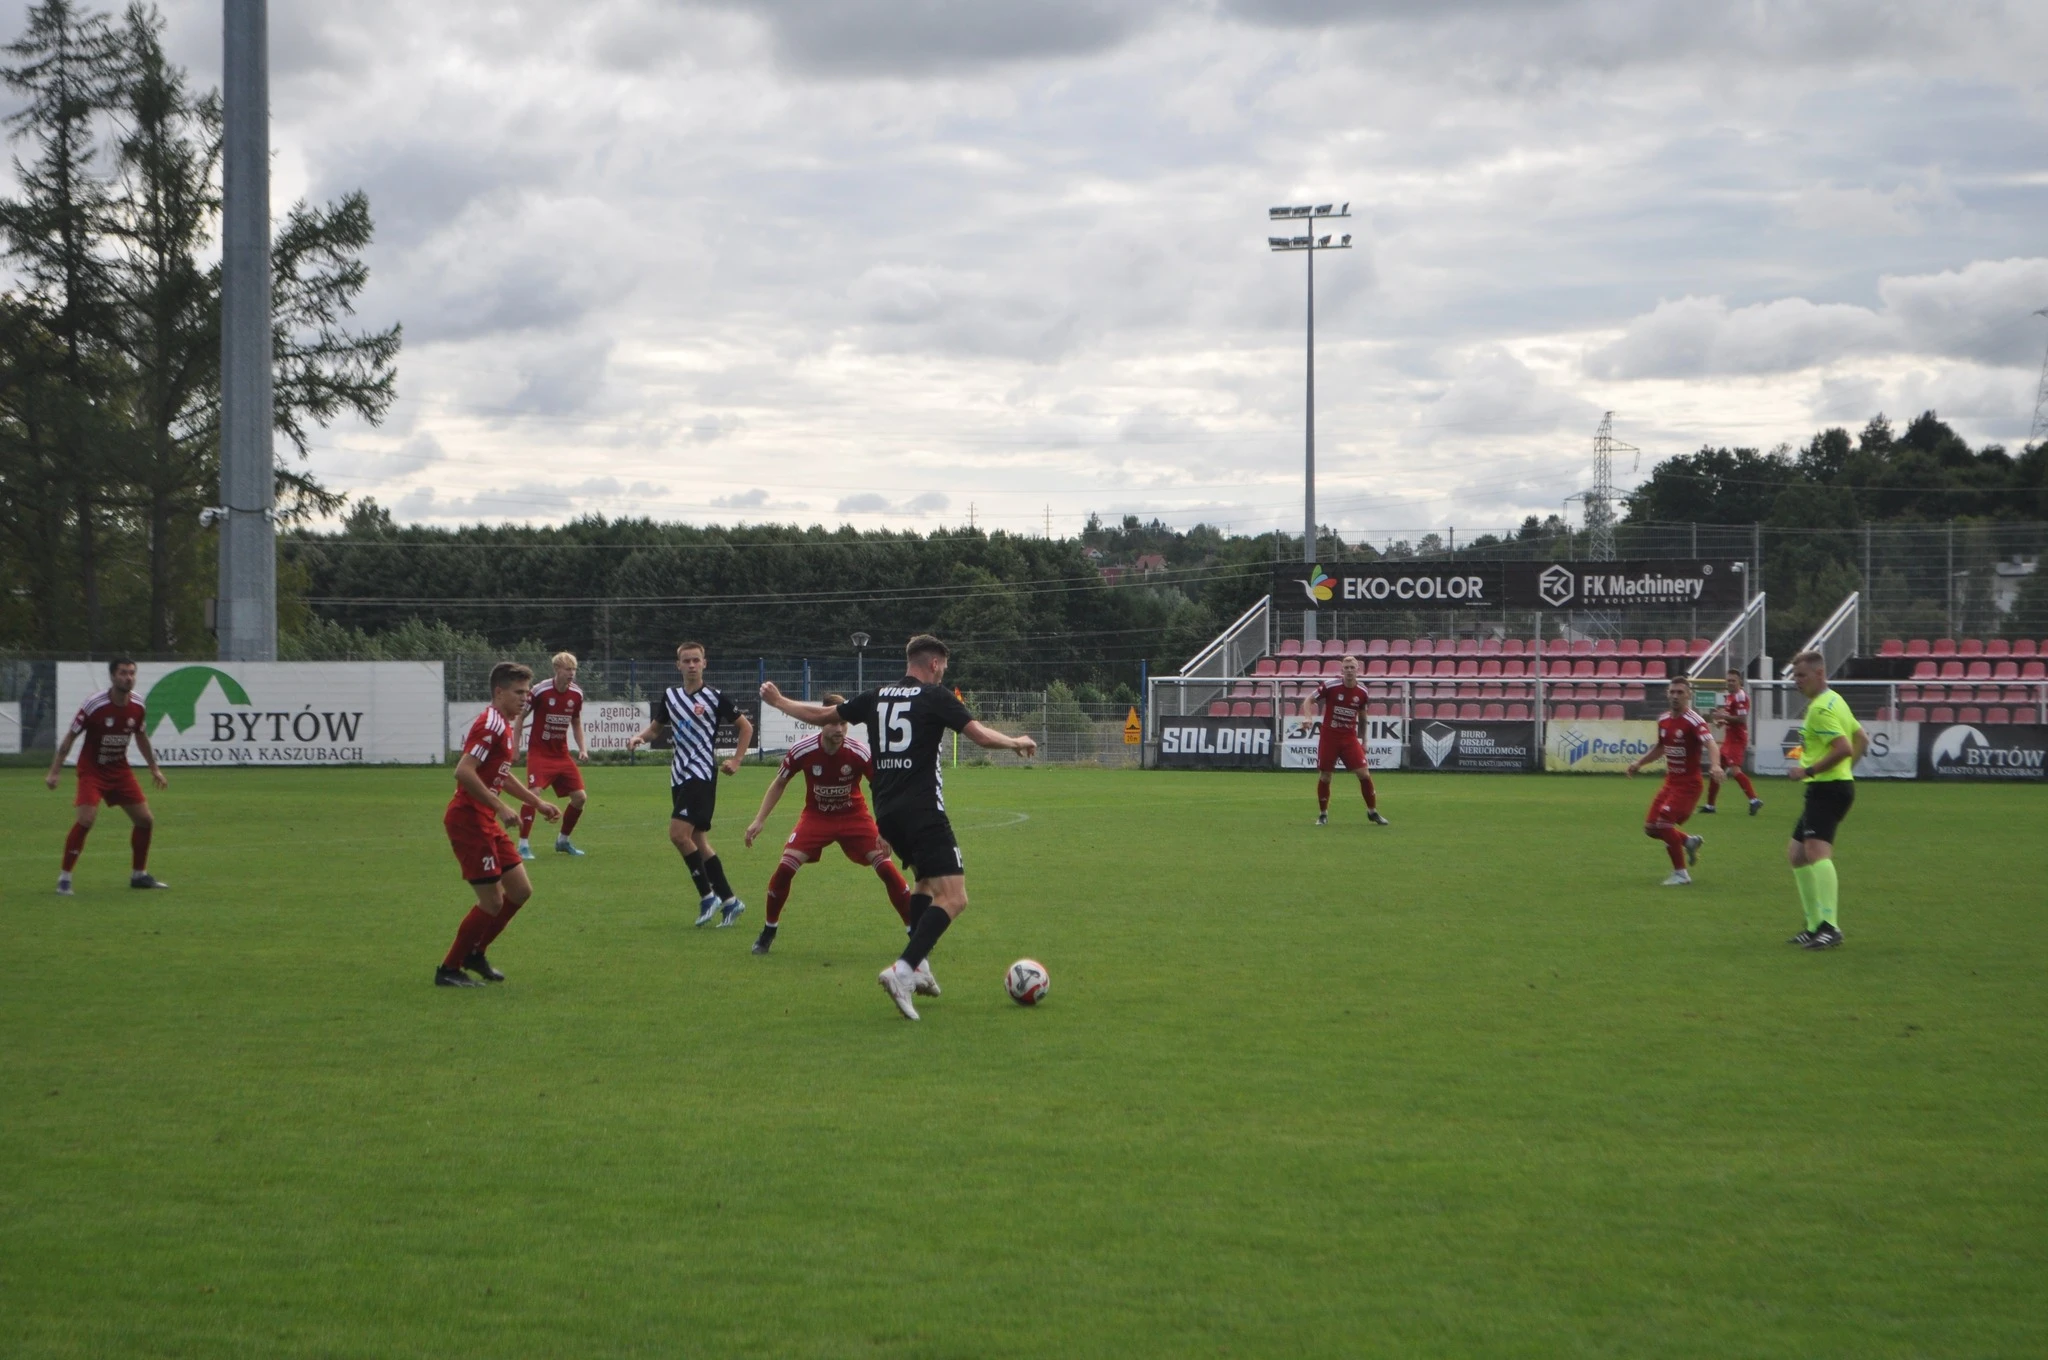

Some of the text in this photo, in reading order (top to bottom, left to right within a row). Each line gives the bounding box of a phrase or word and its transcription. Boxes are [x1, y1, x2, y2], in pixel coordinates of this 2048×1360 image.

[1343, 576, 1484, 599] EKO-COLOR
[1583, 575, 1606, 596] FK
[1609, 573, 1704, 599] Machinery
[600, 704, 641, 720] agencja
[209, 704, 364, 743] BYTÓW
[583, 720, 640, 733] reklamowa
[876, 701, 913, 753] 15
[1162, 727, 1272, 755] SOLDAR
[1460, 730, 1487, 738] BIURO
[1459, 738, 1495, 747] OBSŁUGI
[1592, 738, 1655, 755] Prefab
[155, 747, 364, 762] MIASTO NA KASZUBACH
[1966, 746, 2046, 767] BYTÓW
[876, 758, 913, 770] LUZINO
[1937, 766, 1974, 775] MIASTO
[1975, 767, 1989, 776] NA
[482, 856, 496, 871] 21
